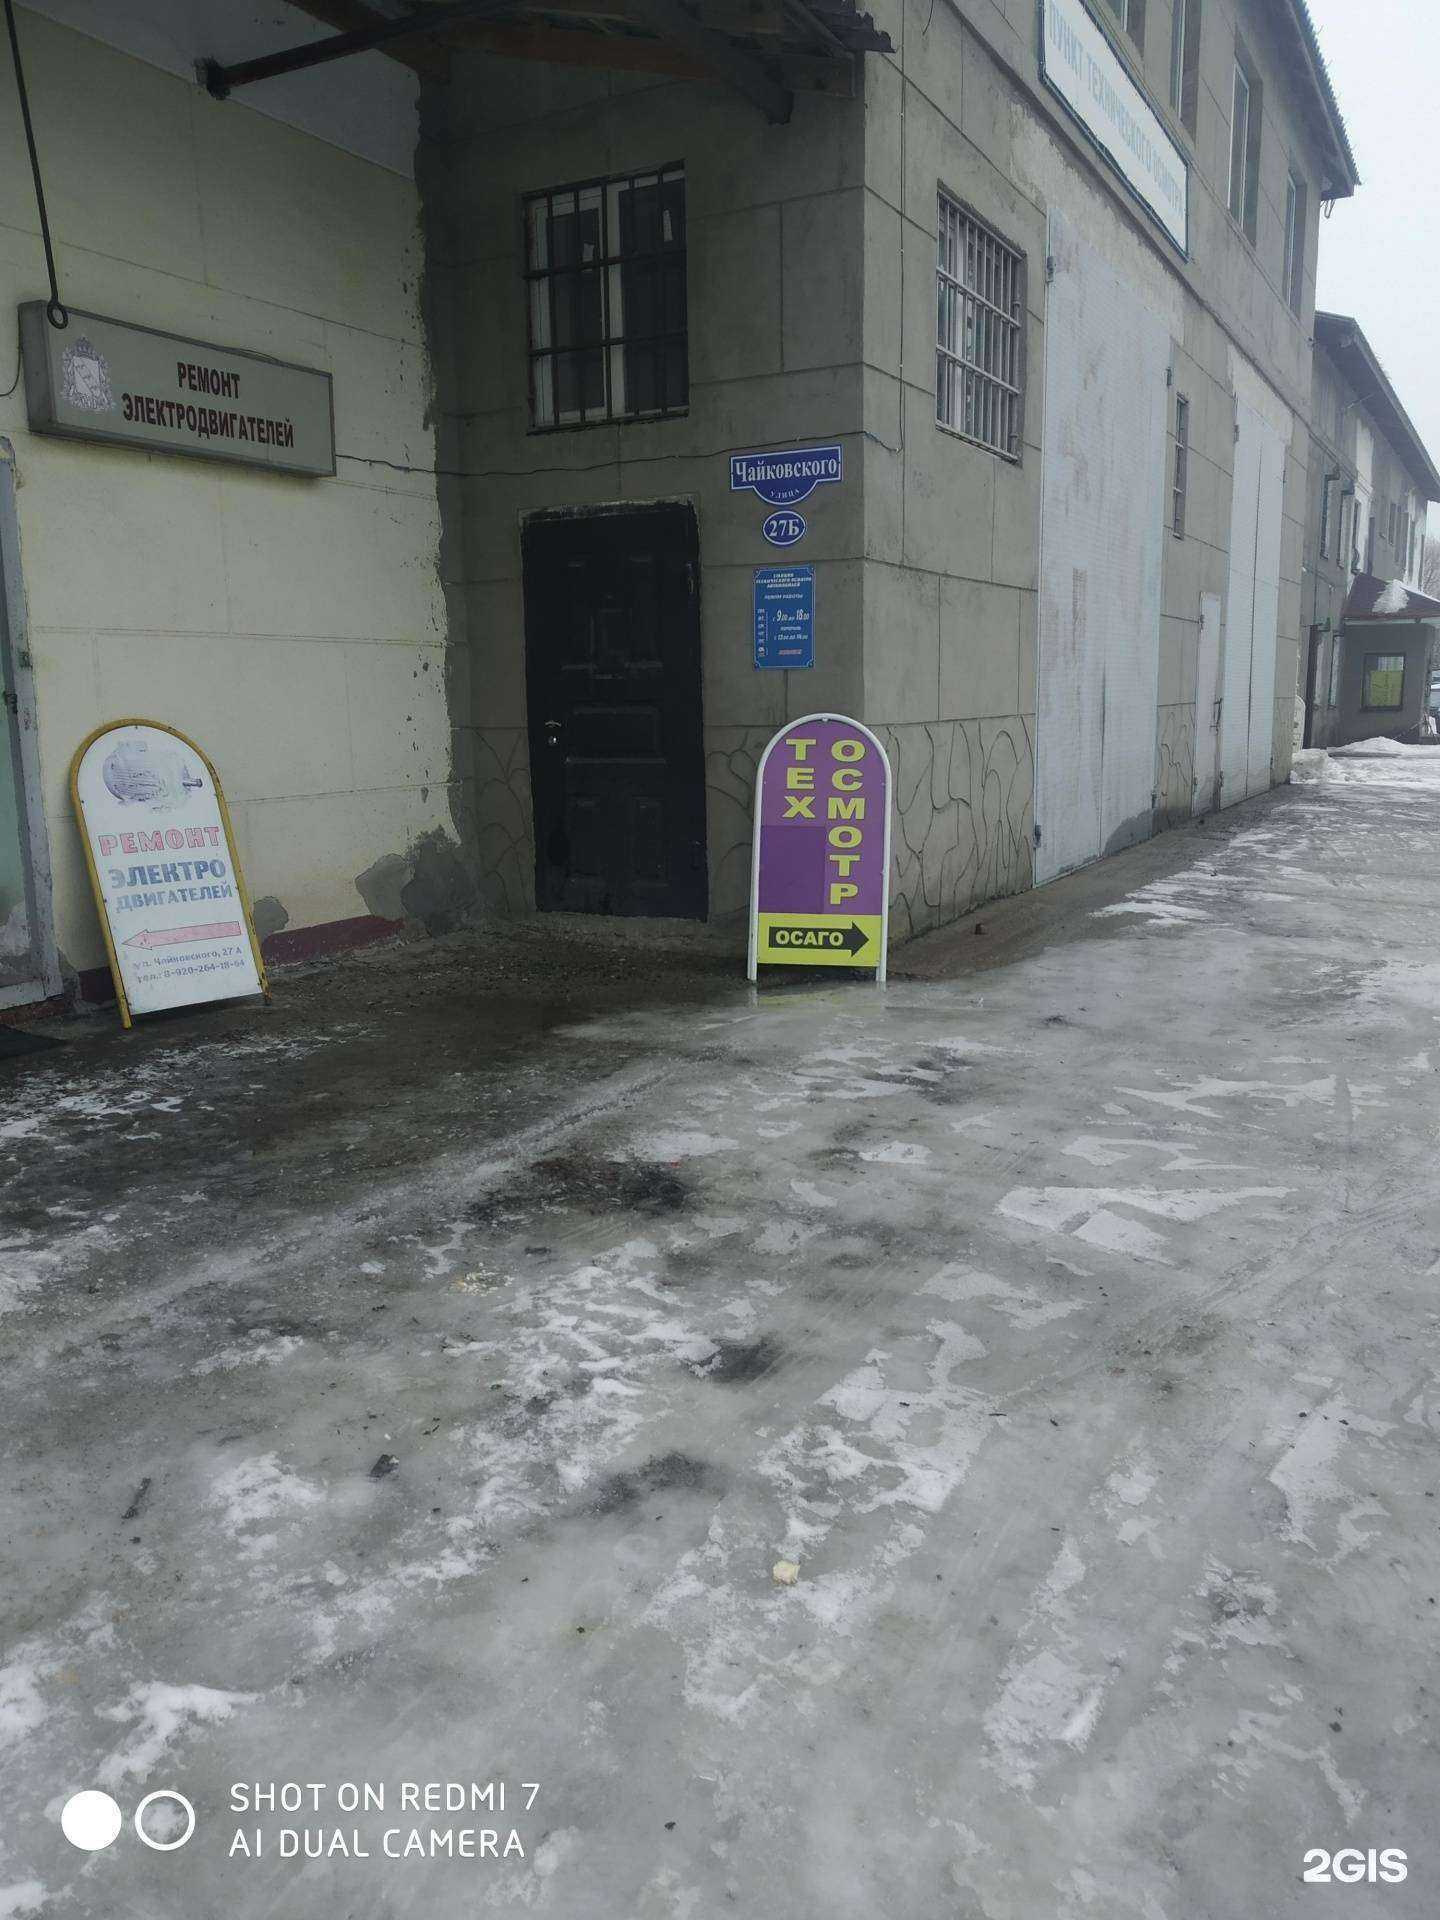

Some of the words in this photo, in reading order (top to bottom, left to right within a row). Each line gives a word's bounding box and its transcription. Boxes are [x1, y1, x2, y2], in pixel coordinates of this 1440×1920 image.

[176, 362, 240, 399] РЕМОНТ
[121, 392, 294, 448] ЭЛЕКТРОДВИГАТЕЛЕЙ
[736, 458, 837, 482] Чайковского
[769, 519, 800, 537] 27Б
[782, 738, 817, 819] ТЕХ
[827, 739, 866, 905] ОСМОТР
[98, 826, 220, 856] РЕМОНТ
[108, 858, 226, 889] ЭЛЕКТРО
[115, 880, 233, 913] ДВИГАТЕЛЕЙ
[222, 947, 233, 956] 27
[775, 930, 844, 946] ОСАГО
